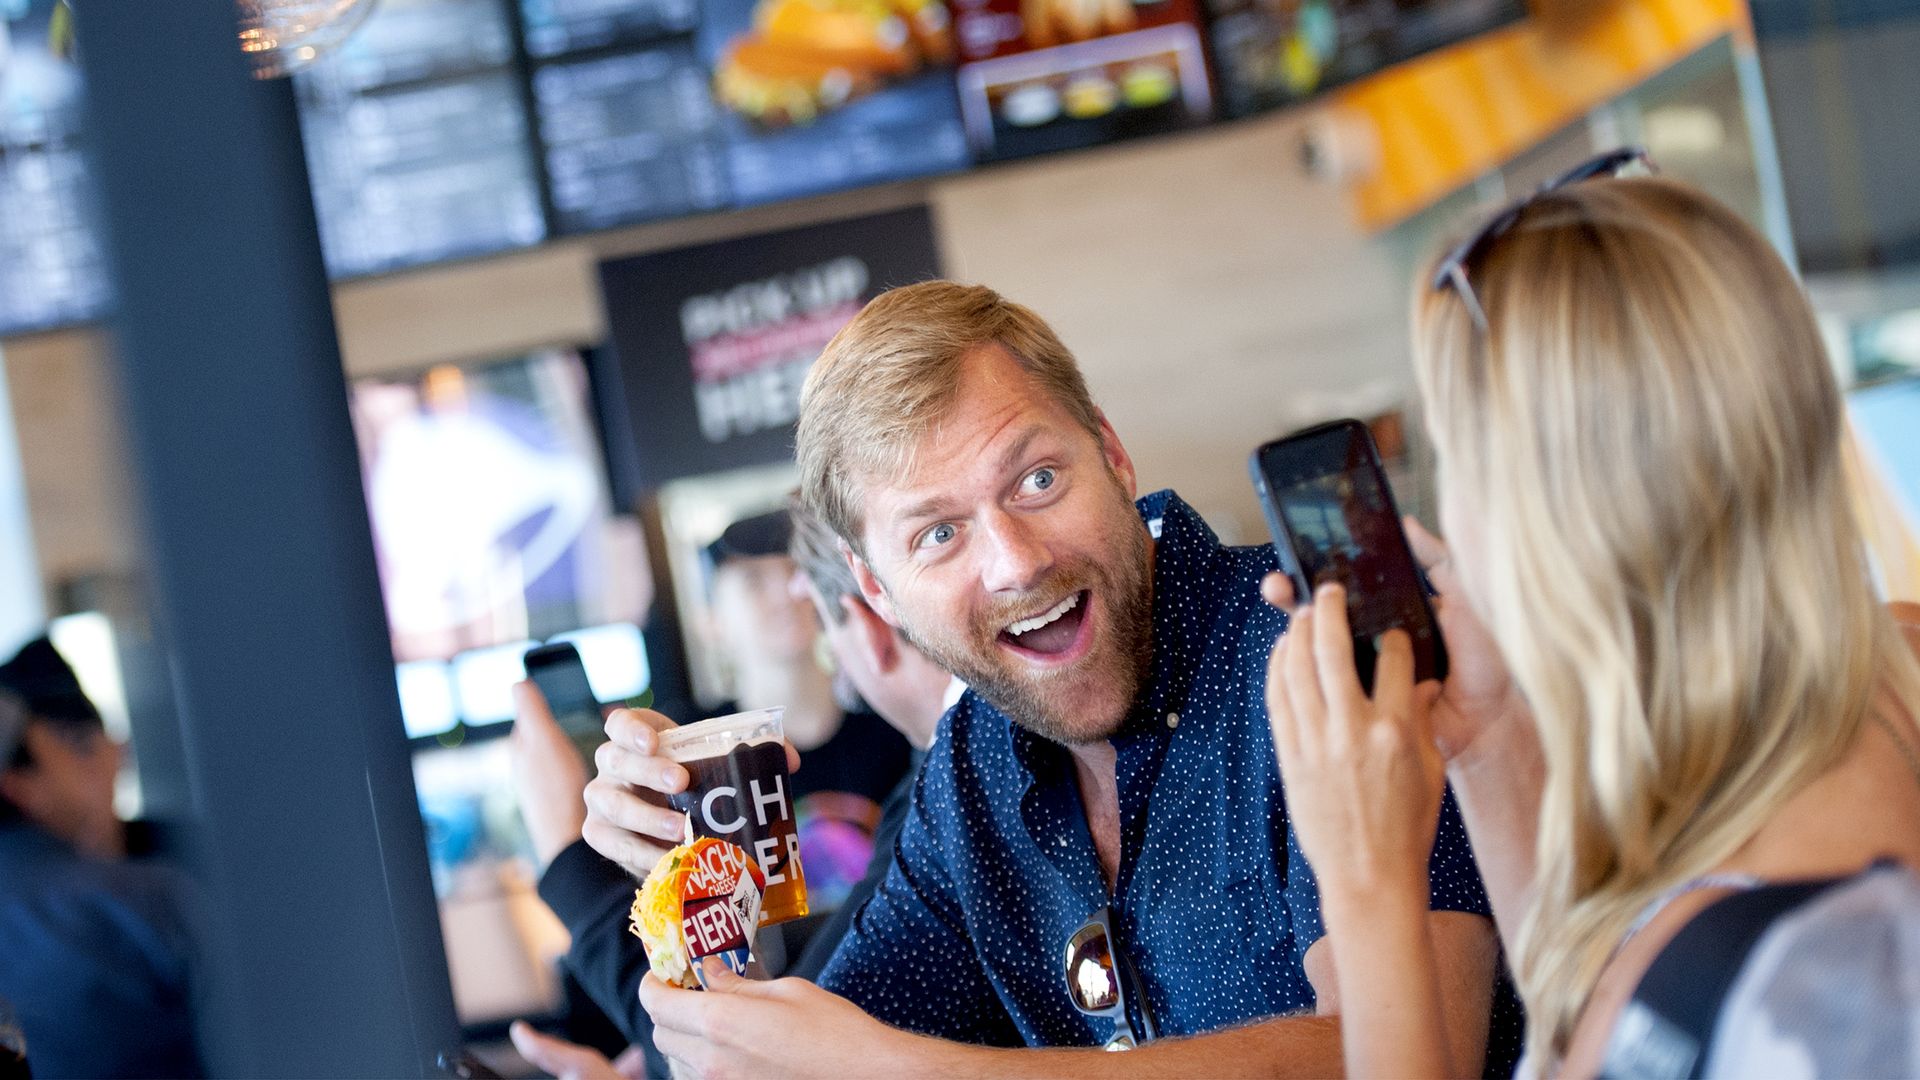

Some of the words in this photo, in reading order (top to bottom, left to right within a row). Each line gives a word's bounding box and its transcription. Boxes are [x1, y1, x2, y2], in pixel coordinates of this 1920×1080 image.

[701, 775, 788, 833] CH
[687, 841, 747, 895] NACHO
[708, 875, 736, 897] CHEESE
[682, 895, 741, 958] FIERY
